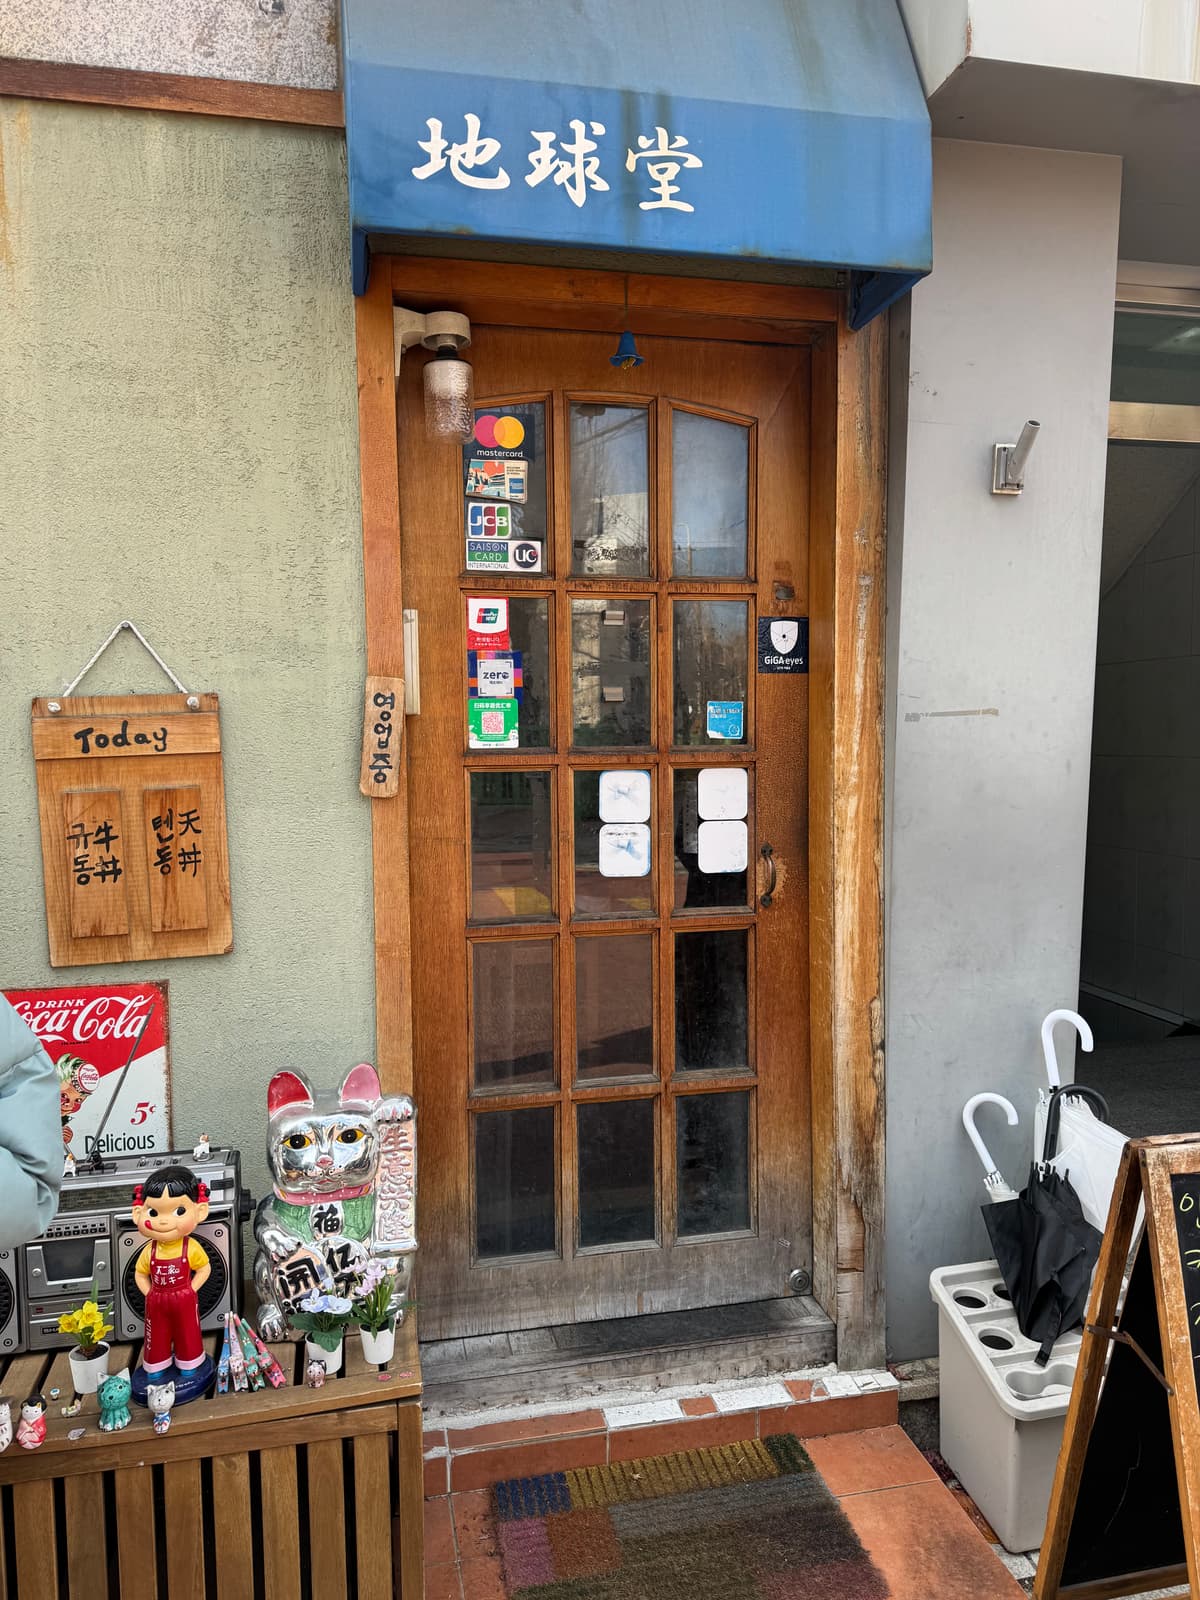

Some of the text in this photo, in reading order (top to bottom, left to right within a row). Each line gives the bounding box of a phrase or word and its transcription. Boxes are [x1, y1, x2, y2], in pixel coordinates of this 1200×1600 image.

[411, 112, 703, 213] 地球堂
[476, 449, 524, 458] mastercard
[469, 515, 508, 527] JCB
[469, 542, 508, 551] SAISON
[475, 552, 503, 562] CARD
[515, 551, 538, 563] UC
[468, 562, 509, 570] INTERNATIONAL
[483, 671, 510, 680] zero
[74, 720, 168, 754] Today
[368, 692, 395, 784] 영업중
[34, 998, 87, 1010] DRINK
[84, 1134, 155, 1154] Delicious
[314, 1203, 341, 1233] 福
[154, 1274, 185, 1286] ミルキー
